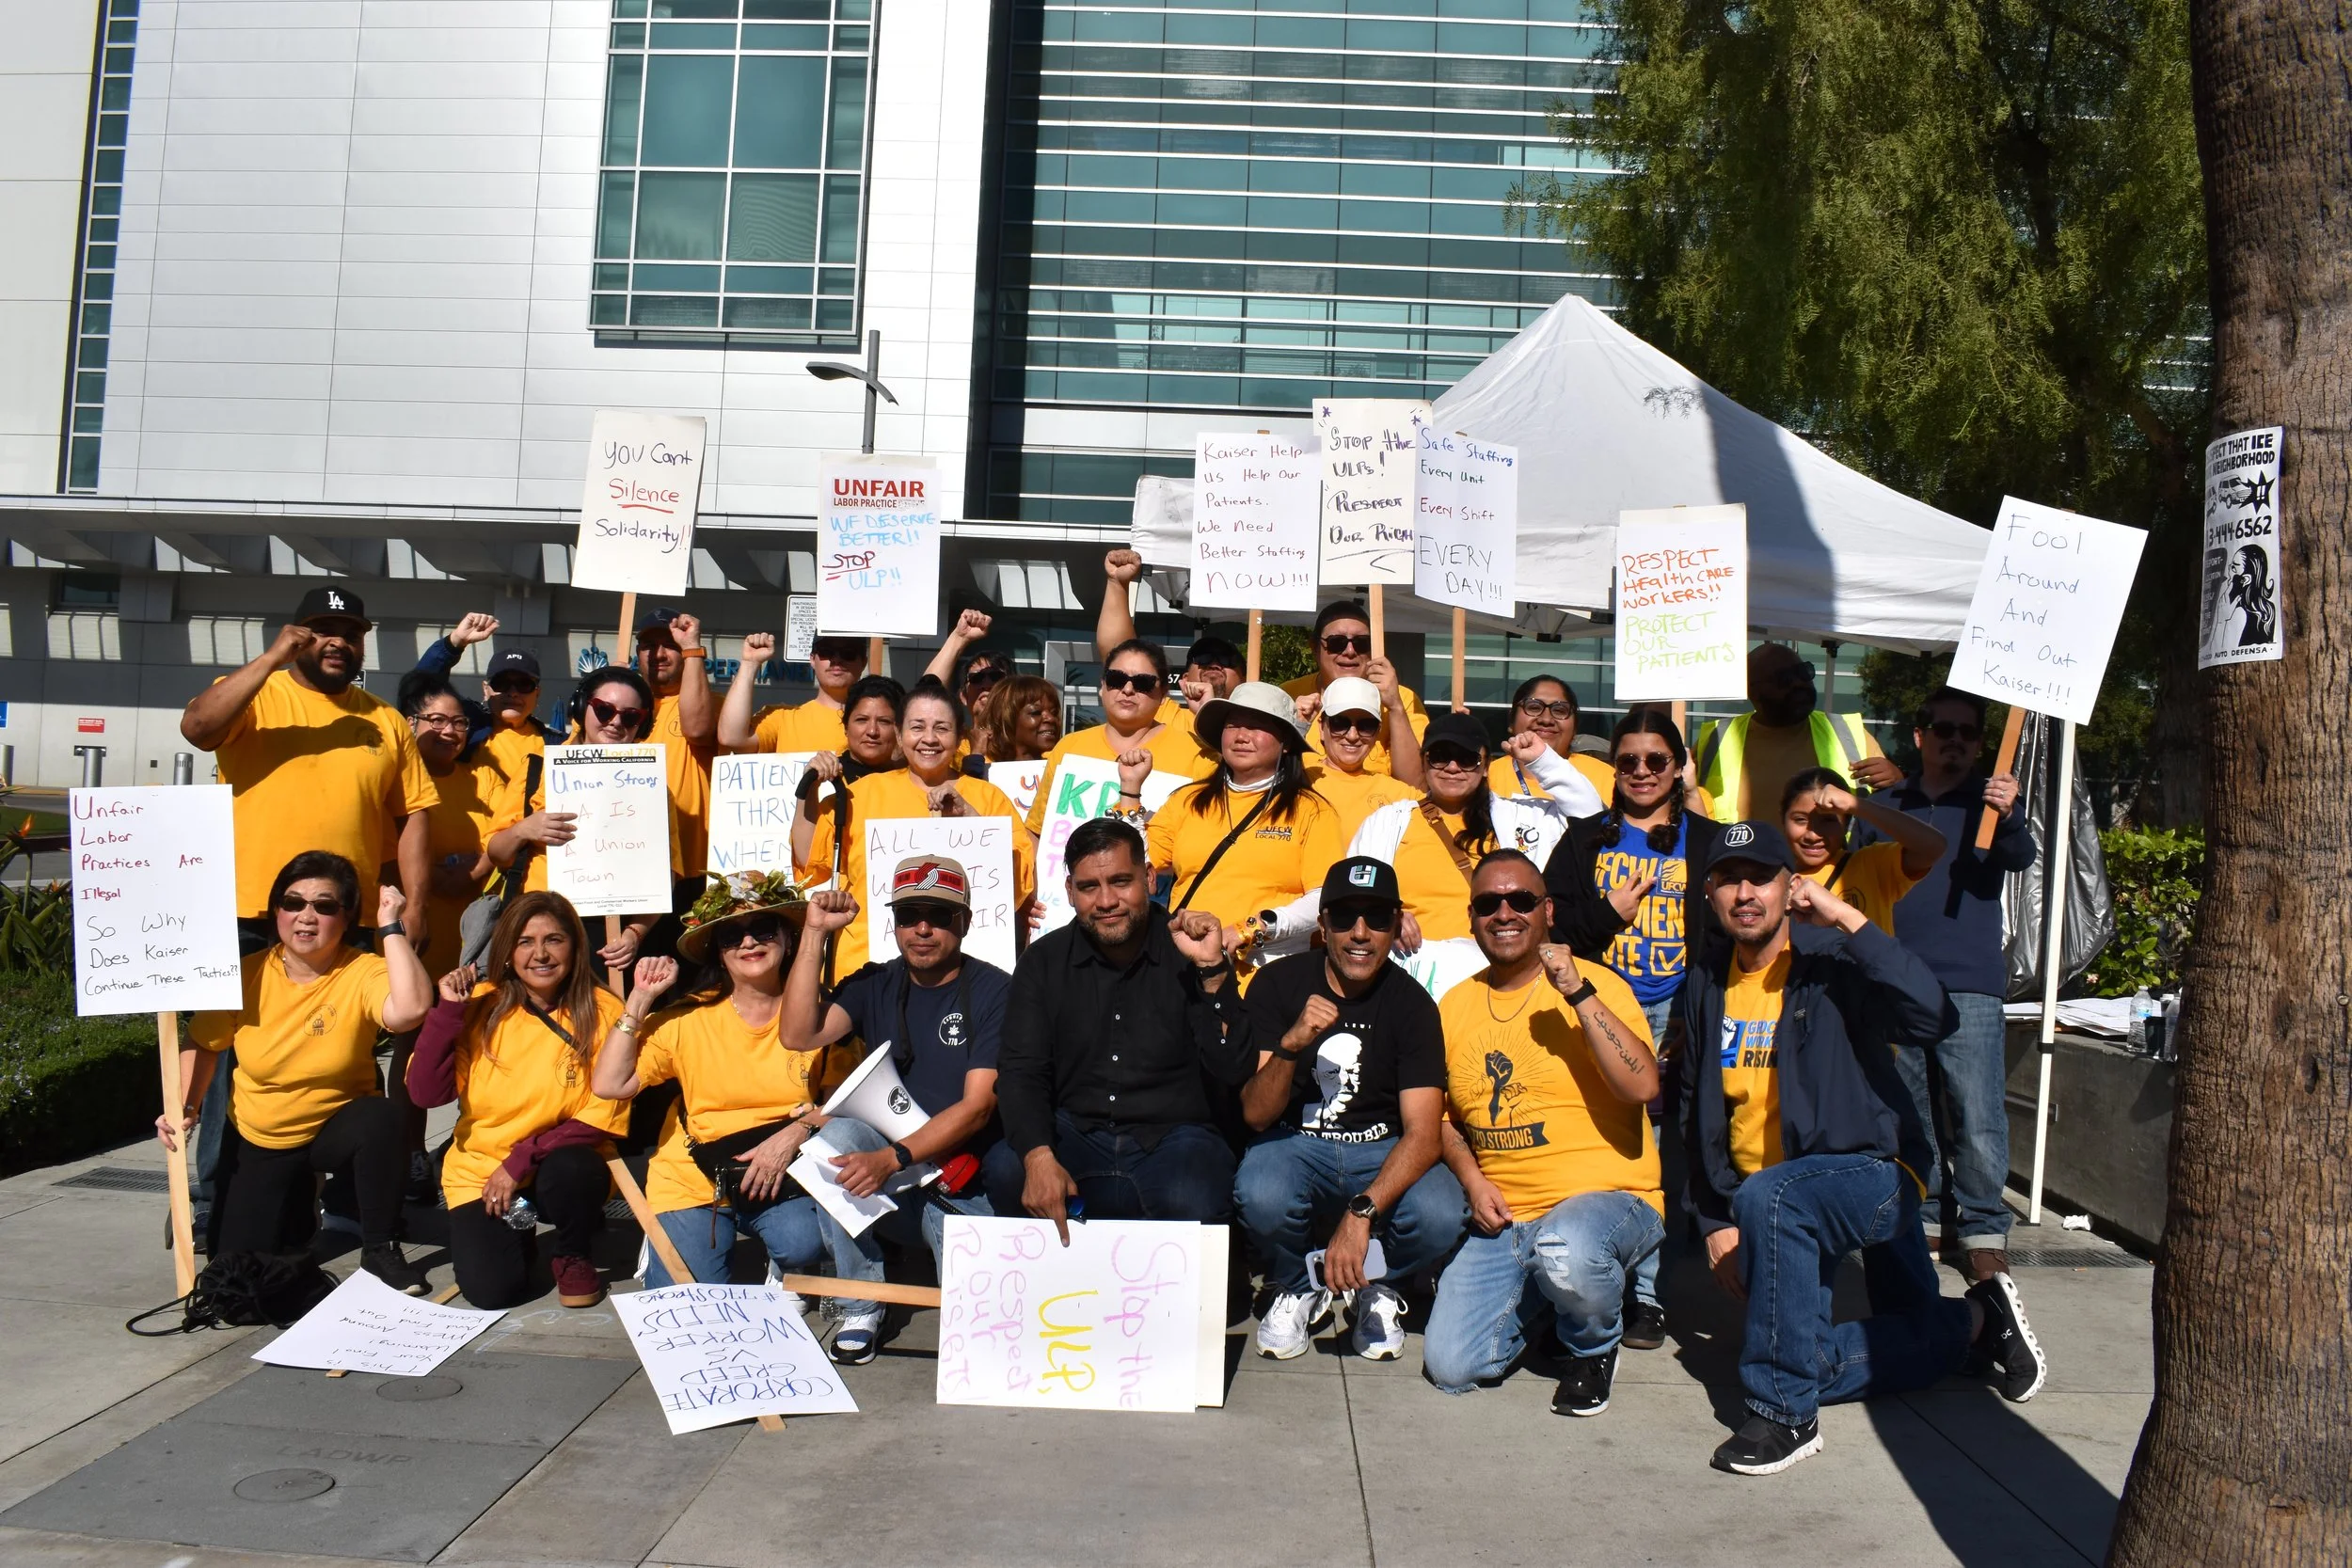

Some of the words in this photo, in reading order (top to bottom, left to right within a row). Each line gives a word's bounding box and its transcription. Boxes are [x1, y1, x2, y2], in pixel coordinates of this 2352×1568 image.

[1203, 442, 1258, 459] Kaiser
[1270, 444, 1303, 459] Help
[1421, 428, 1454, 451] Safe
[1466, 442, 1514, 467] Staffing
[2228, 436, 2249, 454] THAT
[2251, 434, 2274, 450] ICE
[1243, 468, 1270, 482] Help
[1421, 459, 1453, 482] Every
[2212, 451, 2276, 476] NEIGHBORHOOD
[609, 478, 680, 504] Silence
[834, 479, 925, 498] UNFAIR
[1206, 492, 1269, 508] Patients.
[834, 498, 858, 507] LABOR
[861, 499, 898, 508] PRACTICE
[1420, 498, 1453, 519] Every
[1461, 506, 1495, 521] Shift
[2007, 513, 2082, 554] Fool
[822, 550, 876, 569] STOP
[1200, 543, 1247, 560] Better
[1420, 535, 1493, 573] EVERY
[1621, 548, 1720, 578] RESPECT
[1995, 555, 2080, 594] Around
[1445, 572, 1503, 602] DAY!!!
[328, 591, 344, 610] LA
[2000, 597, 2048, 626] And
[1625, 611, 1717, 639] PROTECT
[1624, 636, 1678, 656] OUR
[1971, 626, 2014, 653] Find
[2037, 644, 2077, 667] Out
[2231, 647, 2267, 657] DEFENSA
[566, 749, 603, 758] UFCW
[605, 748, 633, 758] Local
[636, 748, 657, 757] 770
[551, 769, 603, 794] Union
[613, 769, 658, 788] Strong
[73, 795, 144, 820] Unfair
[80, 827, 133, 847] Labor
[595, 837, 645, 853] Union
[870, 826, 922, 861] ALL
[948, 827, 1001, 849] WE
[1730, 830, 1748, 842] 770
[81, 853, 151, 871] Practices
[179, 854, 204, 869] Are
[563, 868, 614, 884] Town
[80, 887, 121, 902] Illegal
[87, 915, 117, 942] So
[141, 912, 186, 933] Why
[90, 947, 130, 969] Does
[145, 943, 189, 960] Kaiser
[85, 975, 144, 996] Continue
[146, 973, 185, 986] These
[1486, 1128, 1534, 1148] STRONG
[637, 1301, 751, 1338] NEEDS
[651, 1317, 808, 1352] WORKER
[680, 1363, 797, 1385] GREED
[662, 1376, 834, 1412] CORPORATE
